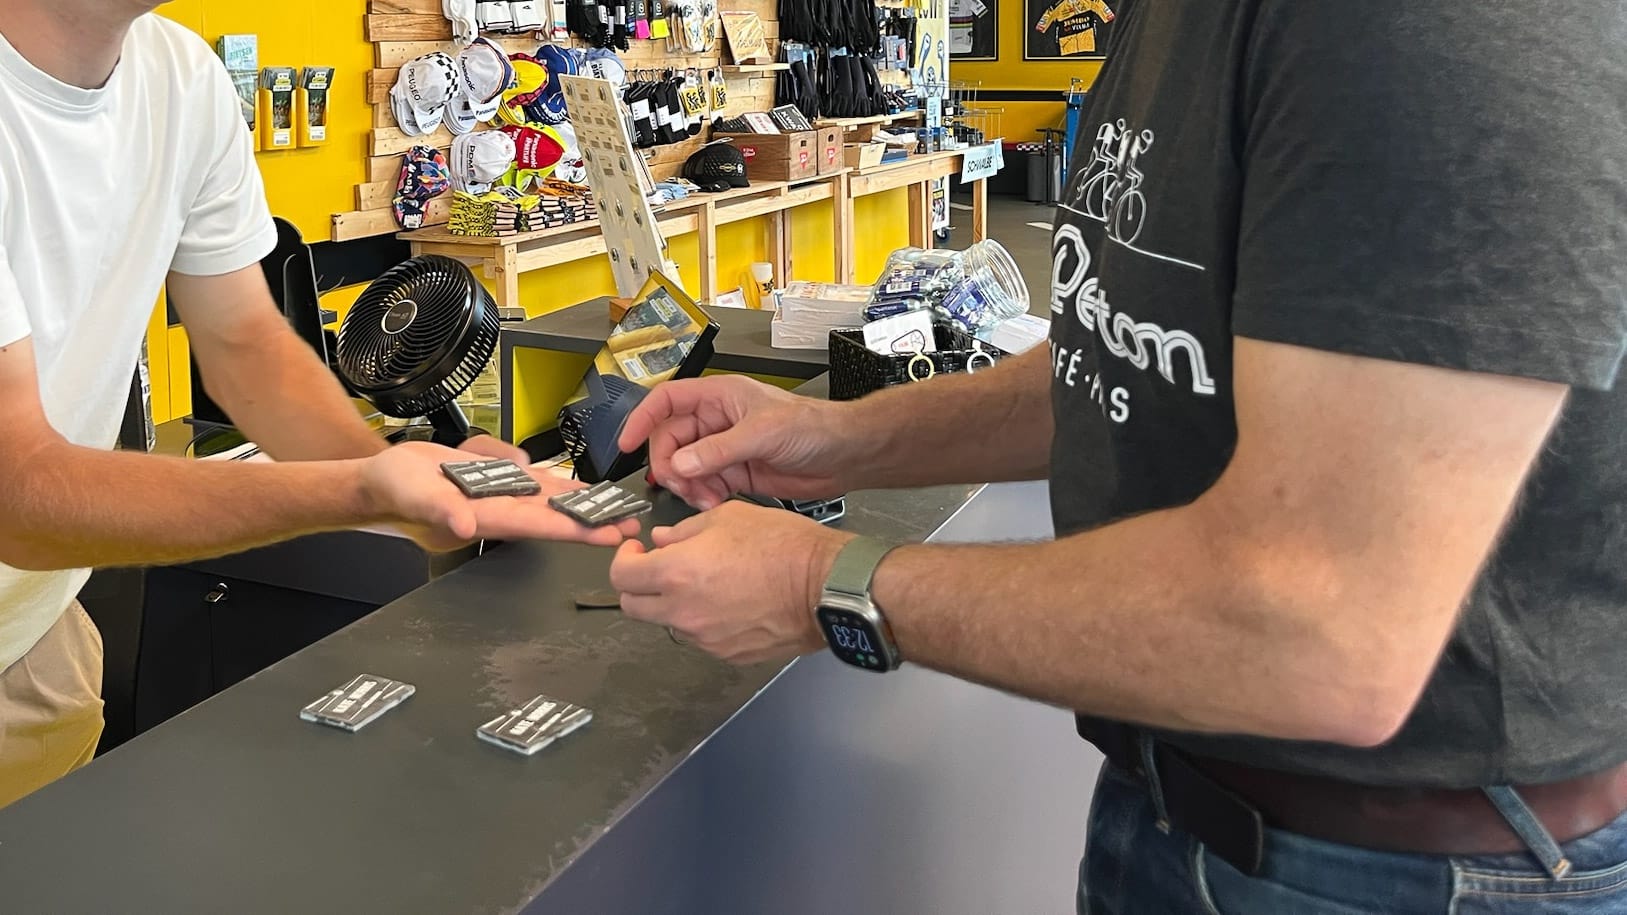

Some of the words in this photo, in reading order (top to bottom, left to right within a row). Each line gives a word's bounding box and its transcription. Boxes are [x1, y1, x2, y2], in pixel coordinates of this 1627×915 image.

[408, 68, 421, 101] PEUGEO
[461, 56, 475, 91] Panasonic
[530, 133, 541, 168] Panasonic
[967, 156, 992, 173] SCHWALBE
